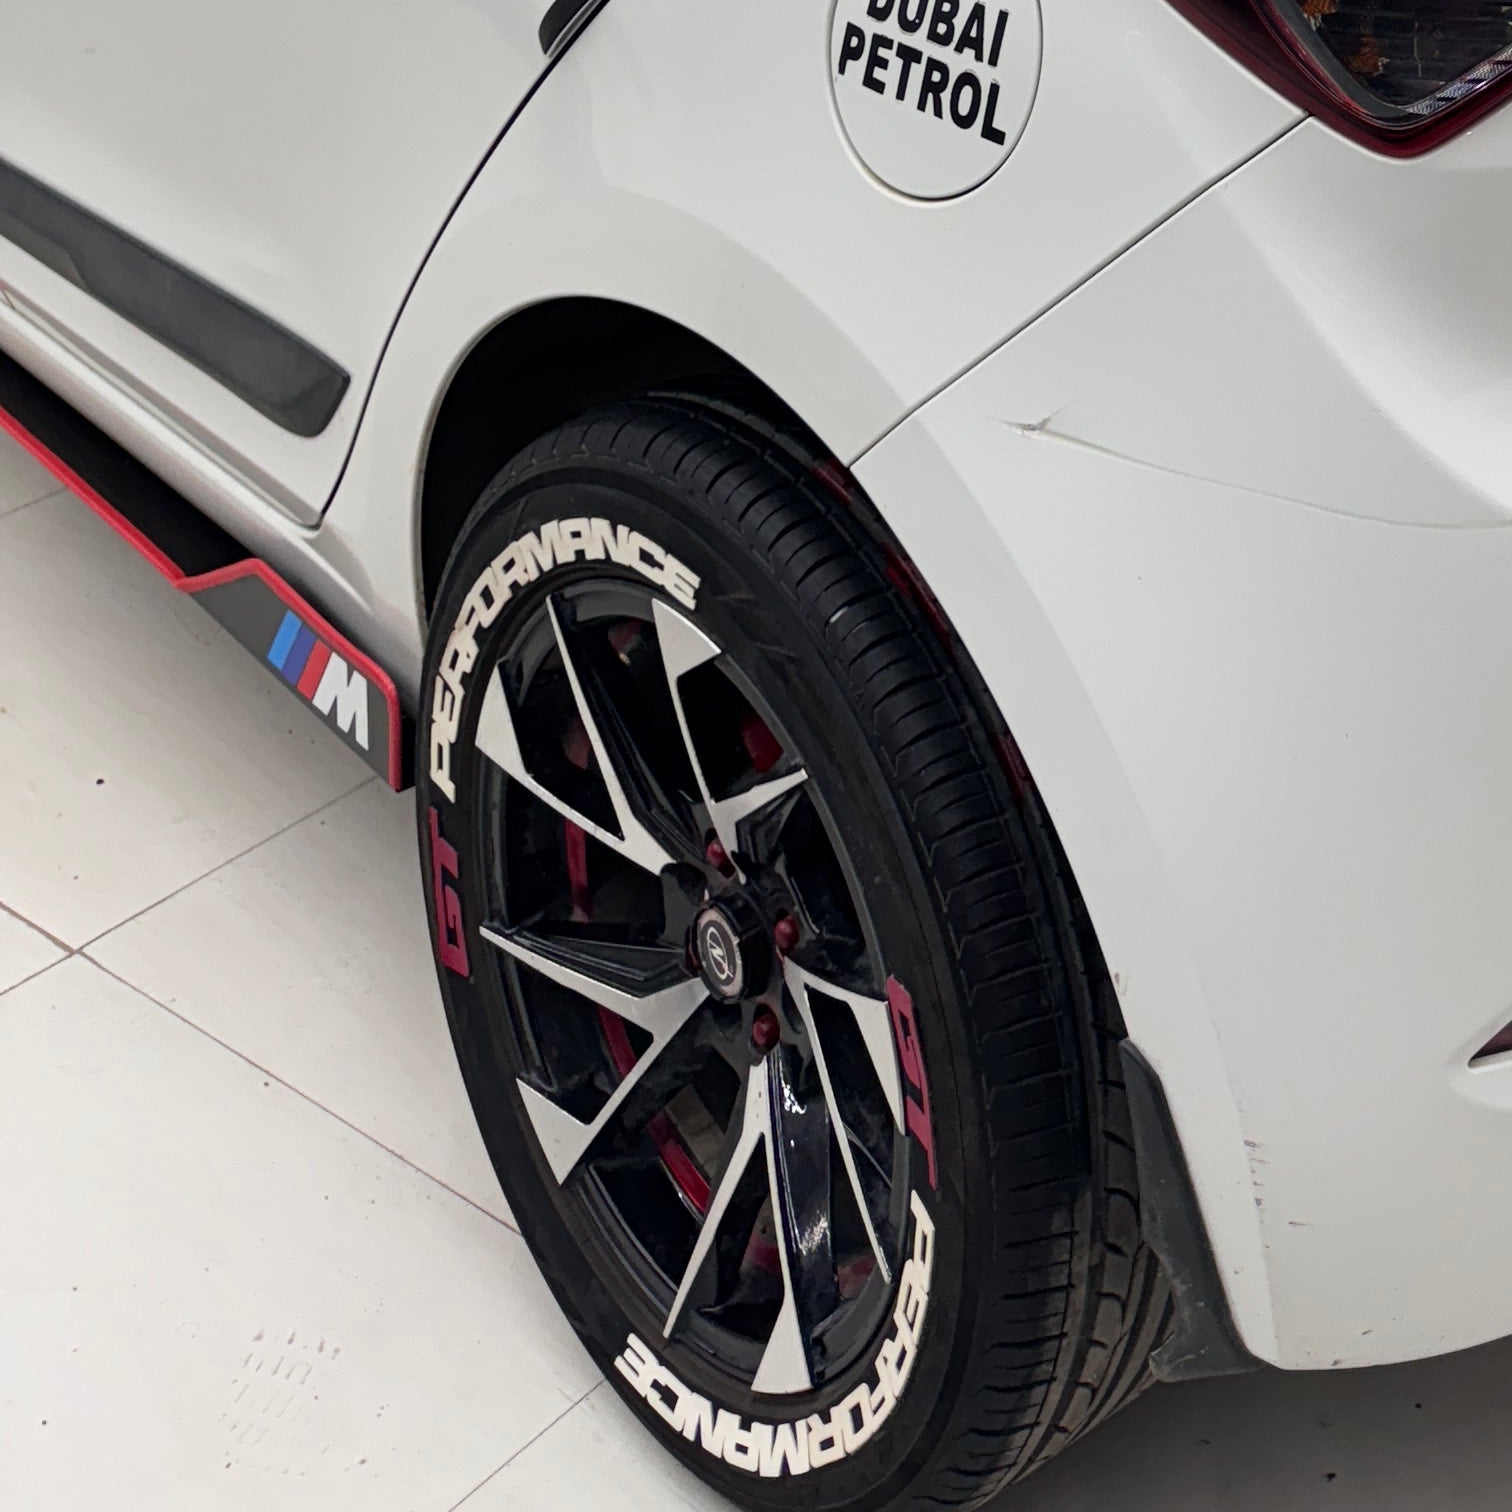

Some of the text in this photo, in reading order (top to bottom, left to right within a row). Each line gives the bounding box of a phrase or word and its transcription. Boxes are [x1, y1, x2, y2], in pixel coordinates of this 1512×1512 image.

[837, 21, 1007, 146] PETROL
[428, 516, 701, 805] PERFORMANCE
[613, 1188, 936, 1478] PERFORMANCE
